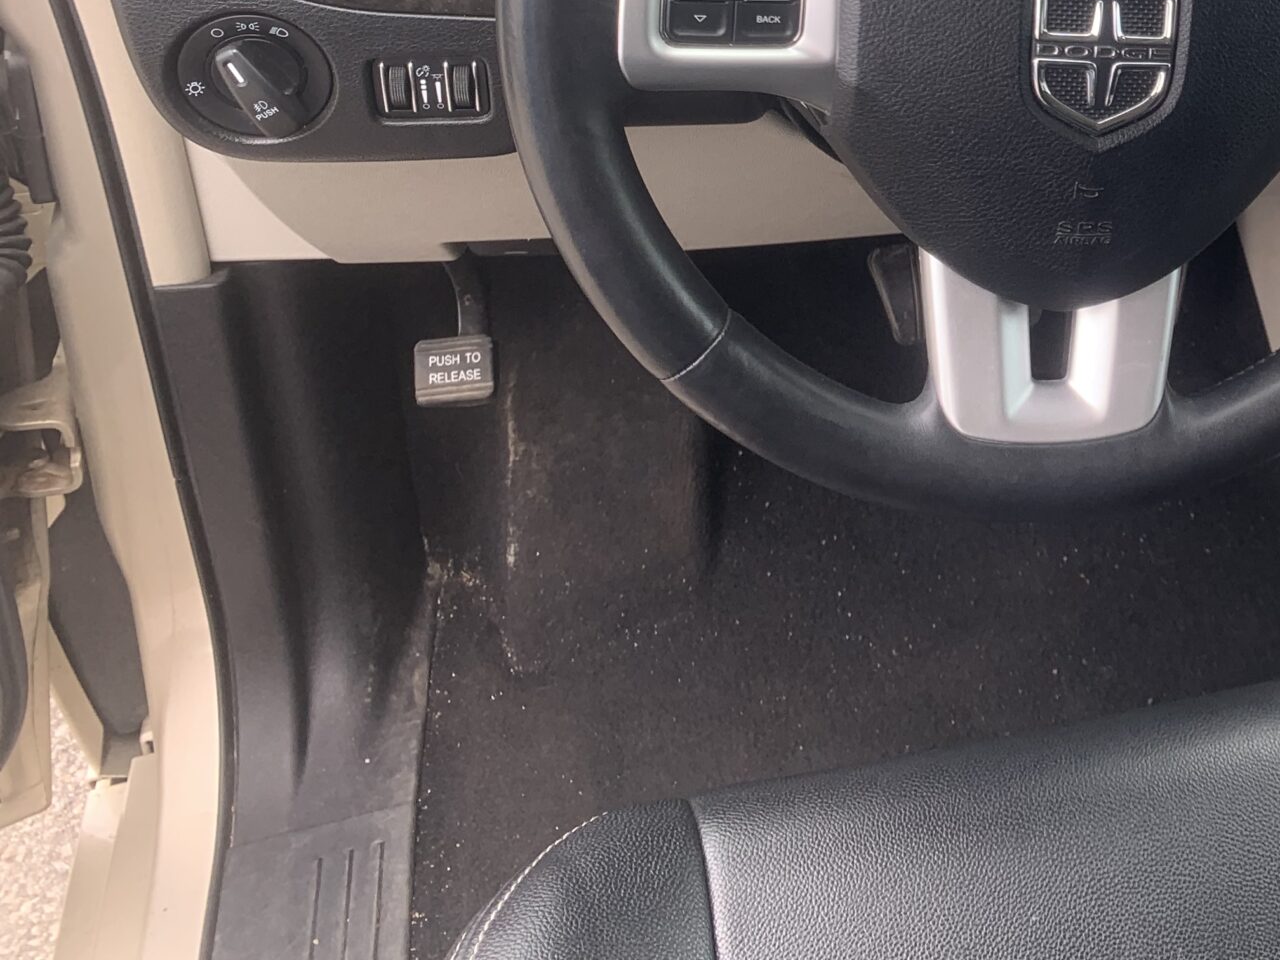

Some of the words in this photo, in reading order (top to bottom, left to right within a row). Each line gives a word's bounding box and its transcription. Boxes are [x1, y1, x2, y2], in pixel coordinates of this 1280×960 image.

[756, 15, 781, 24] BACK
[1036, 43, 1171, 59] DODGE
[255, 106, 279, 121] PUSH
[428, 354, 460, 368] PUSH
[465, 352, 482, 364] TO
[428, 368, 482, 385] RELEASE
